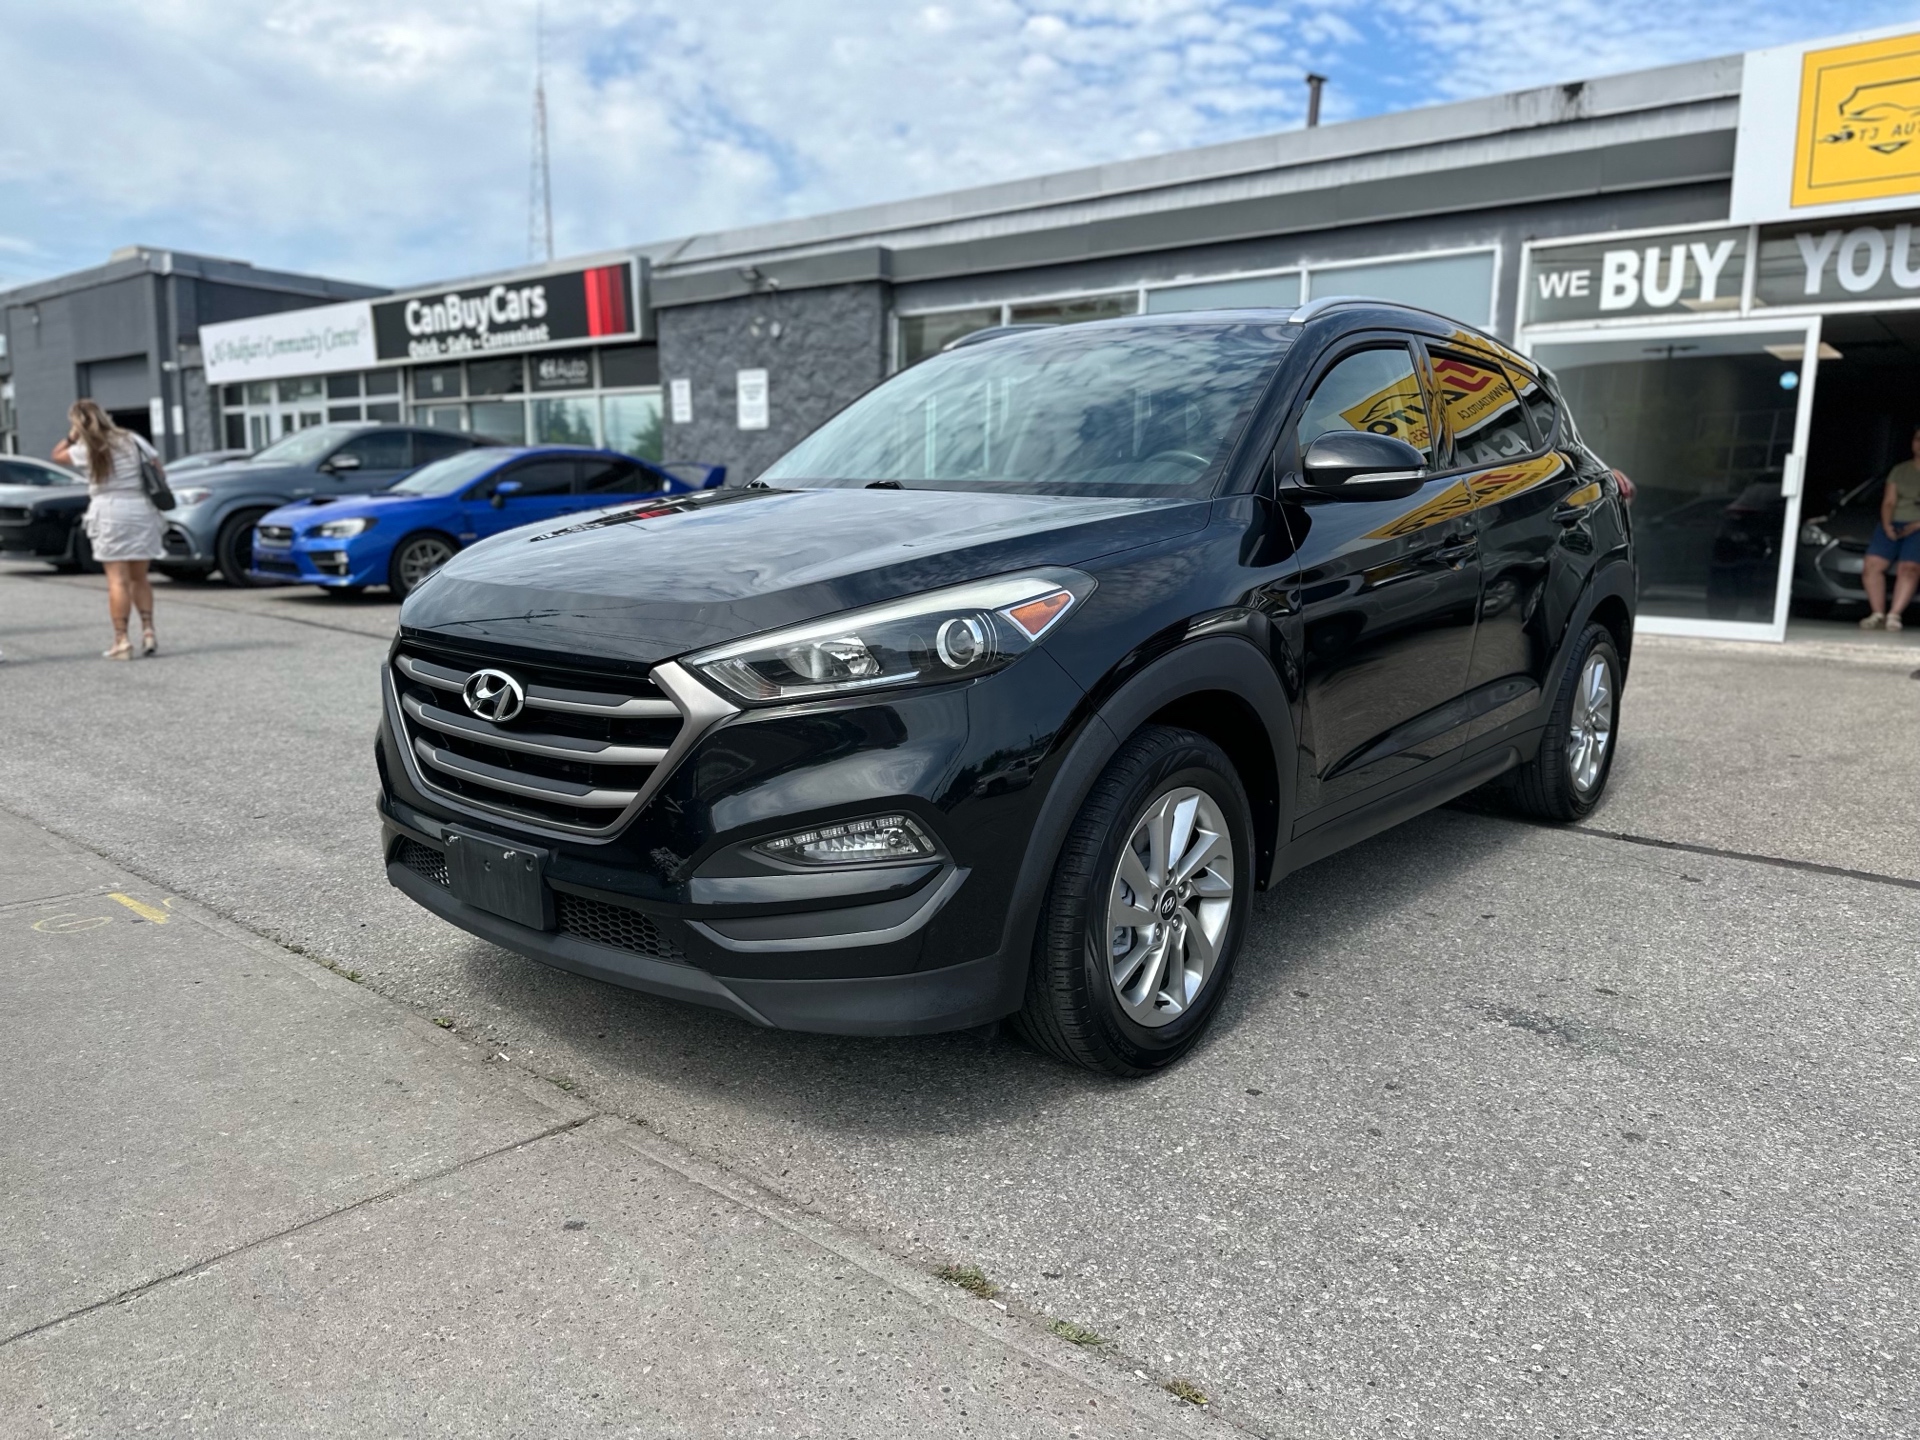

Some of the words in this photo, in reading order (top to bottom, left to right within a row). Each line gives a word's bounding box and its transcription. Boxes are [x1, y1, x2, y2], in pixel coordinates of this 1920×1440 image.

[1891, 121, 1920, 137] AU
[1538, 269, 1591, 299] WE
[1599, 240, 1737, 311] BUY
[405, 285, 548, 336] CanBuyCars
